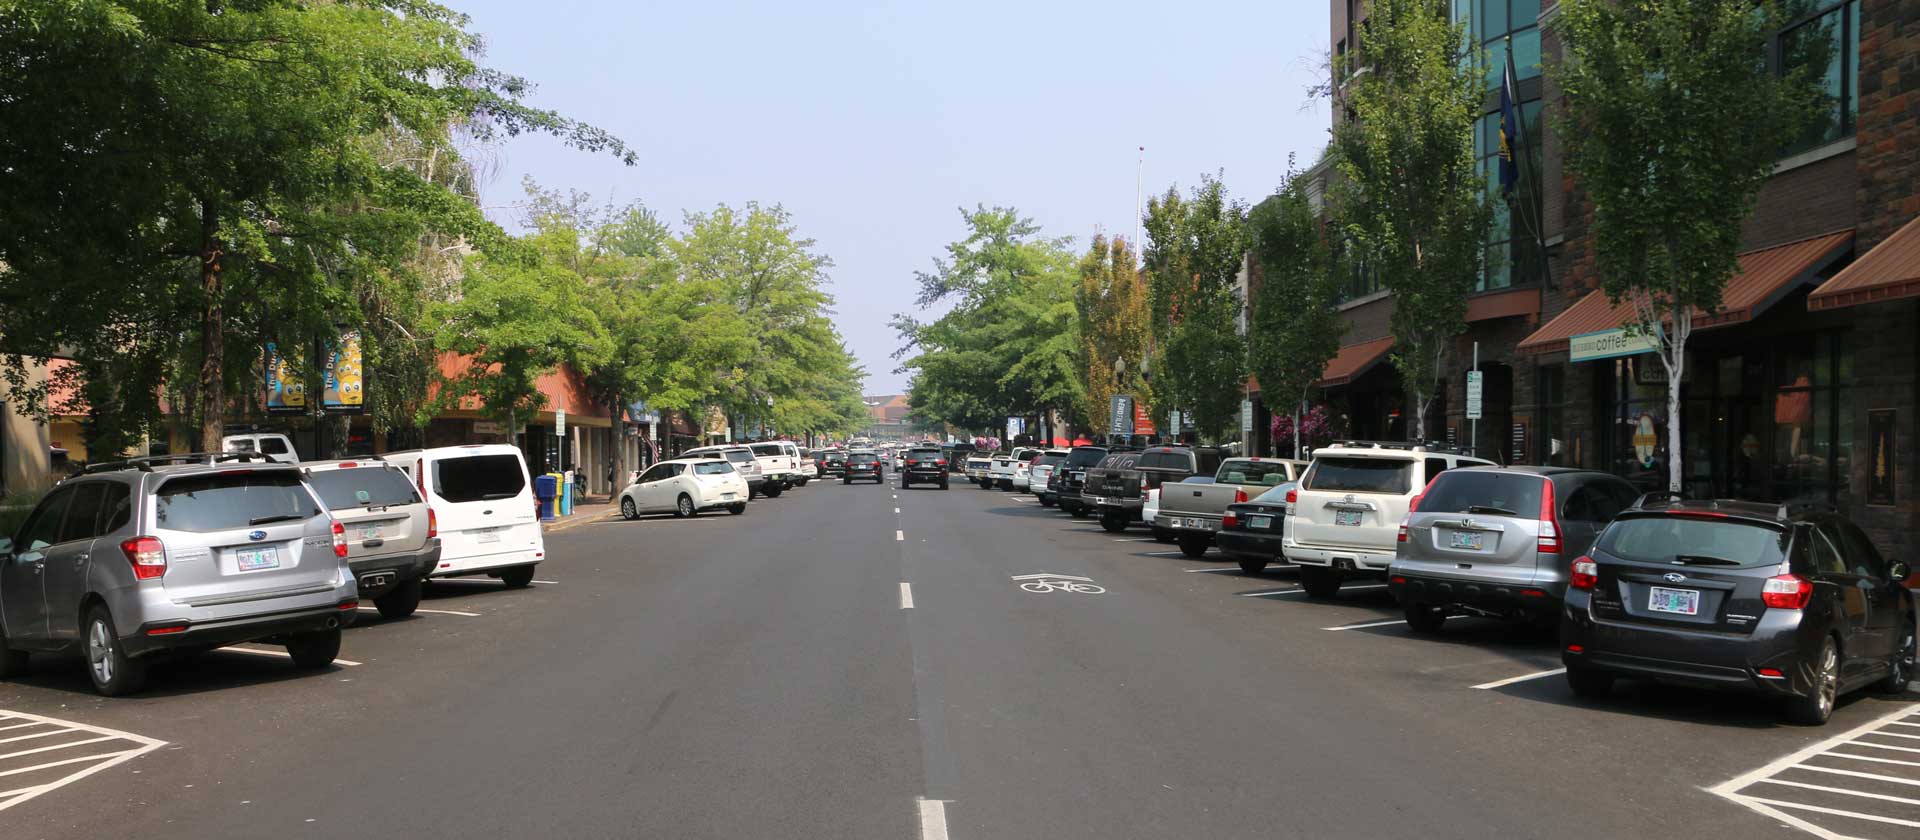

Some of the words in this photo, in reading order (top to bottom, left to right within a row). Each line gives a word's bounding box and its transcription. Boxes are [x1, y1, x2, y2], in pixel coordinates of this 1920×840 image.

[1596, 335, 1627, 352] coffee
[326, 350, 337, 369] Duc
[325, 371, 334, 389] The
